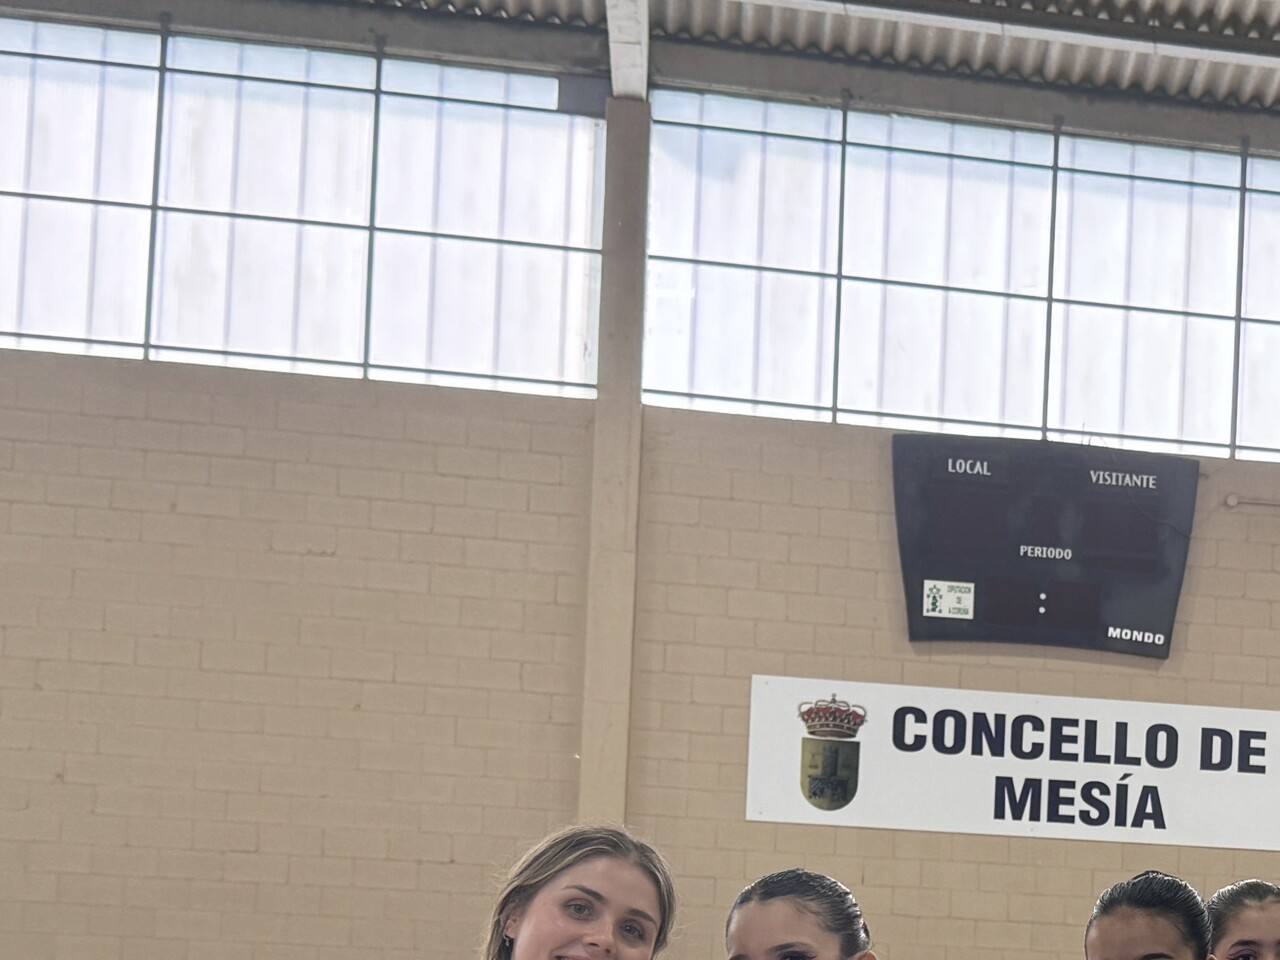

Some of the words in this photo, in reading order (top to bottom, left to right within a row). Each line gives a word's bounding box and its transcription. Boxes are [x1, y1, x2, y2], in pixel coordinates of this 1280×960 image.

[948, 458, 991, 476] LOCAL
[1090, 470, 1157, 489] VISITANTE
[1019, 545, 1073, 560] PERIODO
[1107, 626, 1165, 645] MONDO
[892, 706, 1179, 769] CONCELLO
[1199, 727, 1267, 775] DE
[993, 772, 1167, 830] MESÍA
